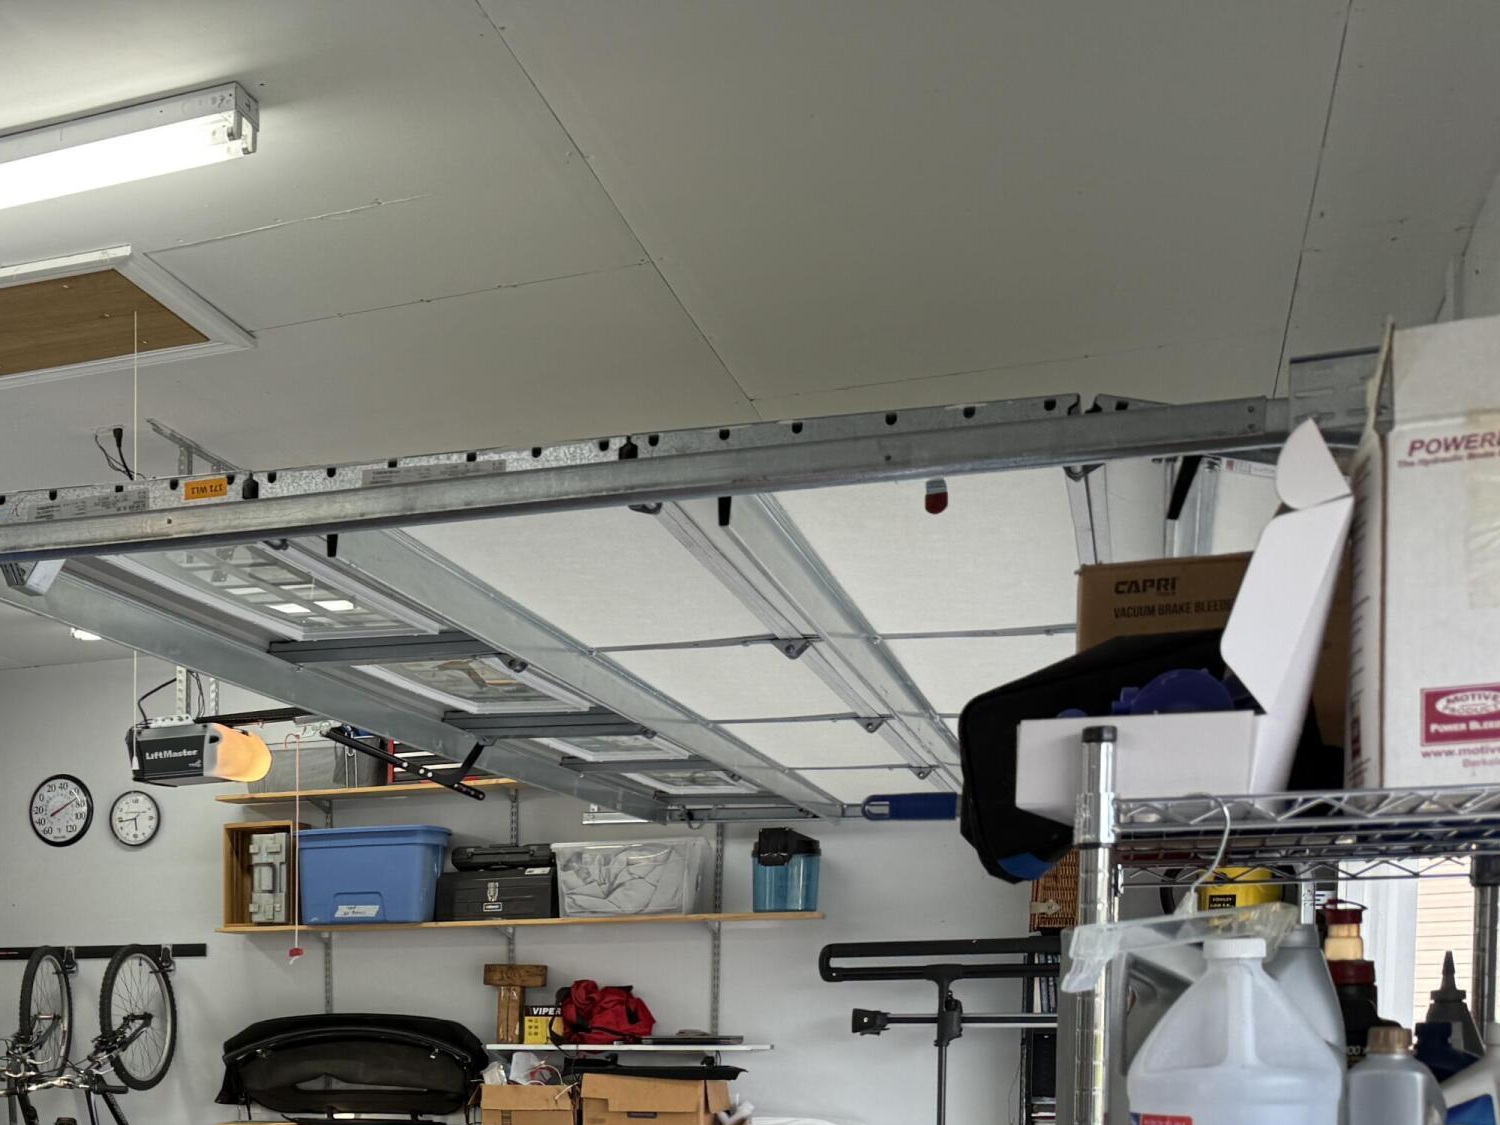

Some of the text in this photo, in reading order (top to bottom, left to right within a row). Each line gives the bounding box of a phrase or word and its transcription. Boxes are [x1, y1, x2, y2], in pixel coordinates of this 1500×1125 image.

[1407, 432, 1500, 457] POWER
[1114, 576, 1177, 595] CAPRI
[1114, 604, 1156, 619] VACUUM
[1158, 601, 1192, 616] BRAKE
[145, 747, 198, 762] LiftMaster
[47, 784, 56, 792] 20
[58, 782, 68, 790] 40
[39, 794, 44, 802] 0
[533, 1007, 561, 1016] VIPER
